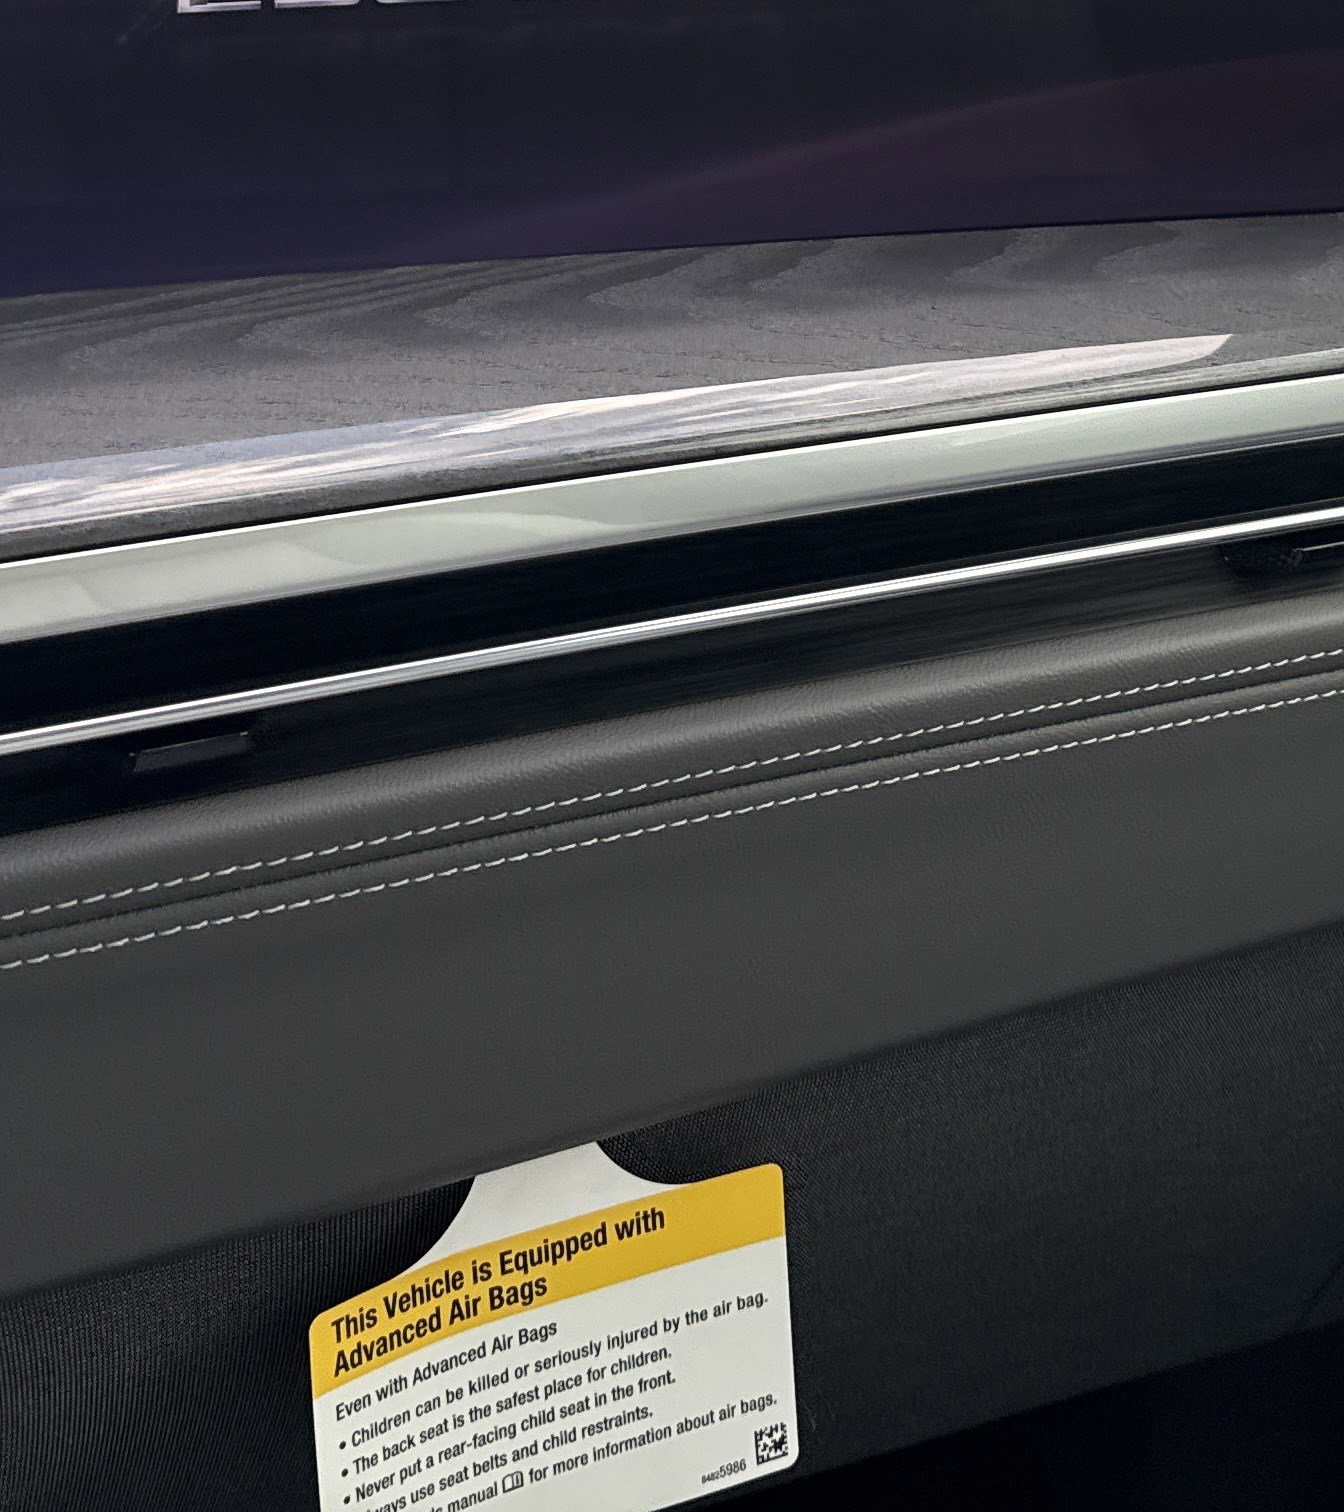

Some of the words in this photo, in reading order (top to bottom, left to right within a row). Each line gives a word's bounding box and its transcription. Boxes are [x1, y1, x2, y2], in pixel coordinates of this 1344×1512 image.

[331, 1307, 377, 1343] This
[383, 1269, 464, 1319] Vehicle
[472, 1259, 492, 1284] is
[499, 1221, 607, 1276] Equipped
[614, 1207, 665, 1241] with
[334, 1306, 442, 1378] Advanced
[449, 1294, 481, 1325] Air
[489, 1277, 548, 1311] Bags
[336, 1393, 371, 1421] Even
[375, 1375, 408, 1402] with
[412, 1341, 486, 1386] Advanced
[491, 1334, 514, 1355] Air
[518, 1322, 557, 1346] Bags
[351, 1409, 411, 1447] Children
[415, 1395, 441, 1417] can
[446, 1388, 464, 1405] be
[468, 1367, 509, 1396] killed
[514, 1364, 530, 1379] or
[534, 1340, 602, 1373] seriously
[606, 1320, 658, 1350] injured
[663, 1316, 680, 1334] by
[685, 1309, 707, 1326] the
[712, 1300, 732, 1317] air
[736, 1292, 768, 1311] bag.
[352, 1453, 378, 1475] The
[383, 1434, 416, 1462] back
[419, 1418, 449, 1444] seat
[452, 1414, 464, 1430] is
[468, 1404, 491, 1423] the
[496, 1385, 540, 1414] safest
[544, 1373, 582, 1400] place
[586, 1366, 606, 1383] for
[610, 1347, 672, 1375] children.
[355, 1472, 395, 1502] Never
[399, 1458, 422, 1485] put
[425, 1455, 434, 1469] a
[438, 1423, 517, 1464] rear-facing
[520, 1406, 555, 1432] child
[559, 1396, 591, 1419] seat
[593, 1392, 607, 1408] in
[611, 1384, 634, 1402] the
[638, 1369, 676, 1394] front.
[410, 1483, 435, 1504] use
[438, 1466, 469, 1491] seat
[472, 1453, 507, 1477] belts
[512, 1439, 538, 1463] and
[542, 1427, 577, 1452] child
[581, 1405, 653, 1439] restraints.
[447, 1481, 498, 1512] manual
[528, 1465, 549, 1484] for
[553, 1452, 588, 1476] more
[593, 1425, 672, 1463] information
[676, 1409, 715, 1435] about
[719, 1403, 736, 1422] air
[740, 1393, 777, 1414] bags.
